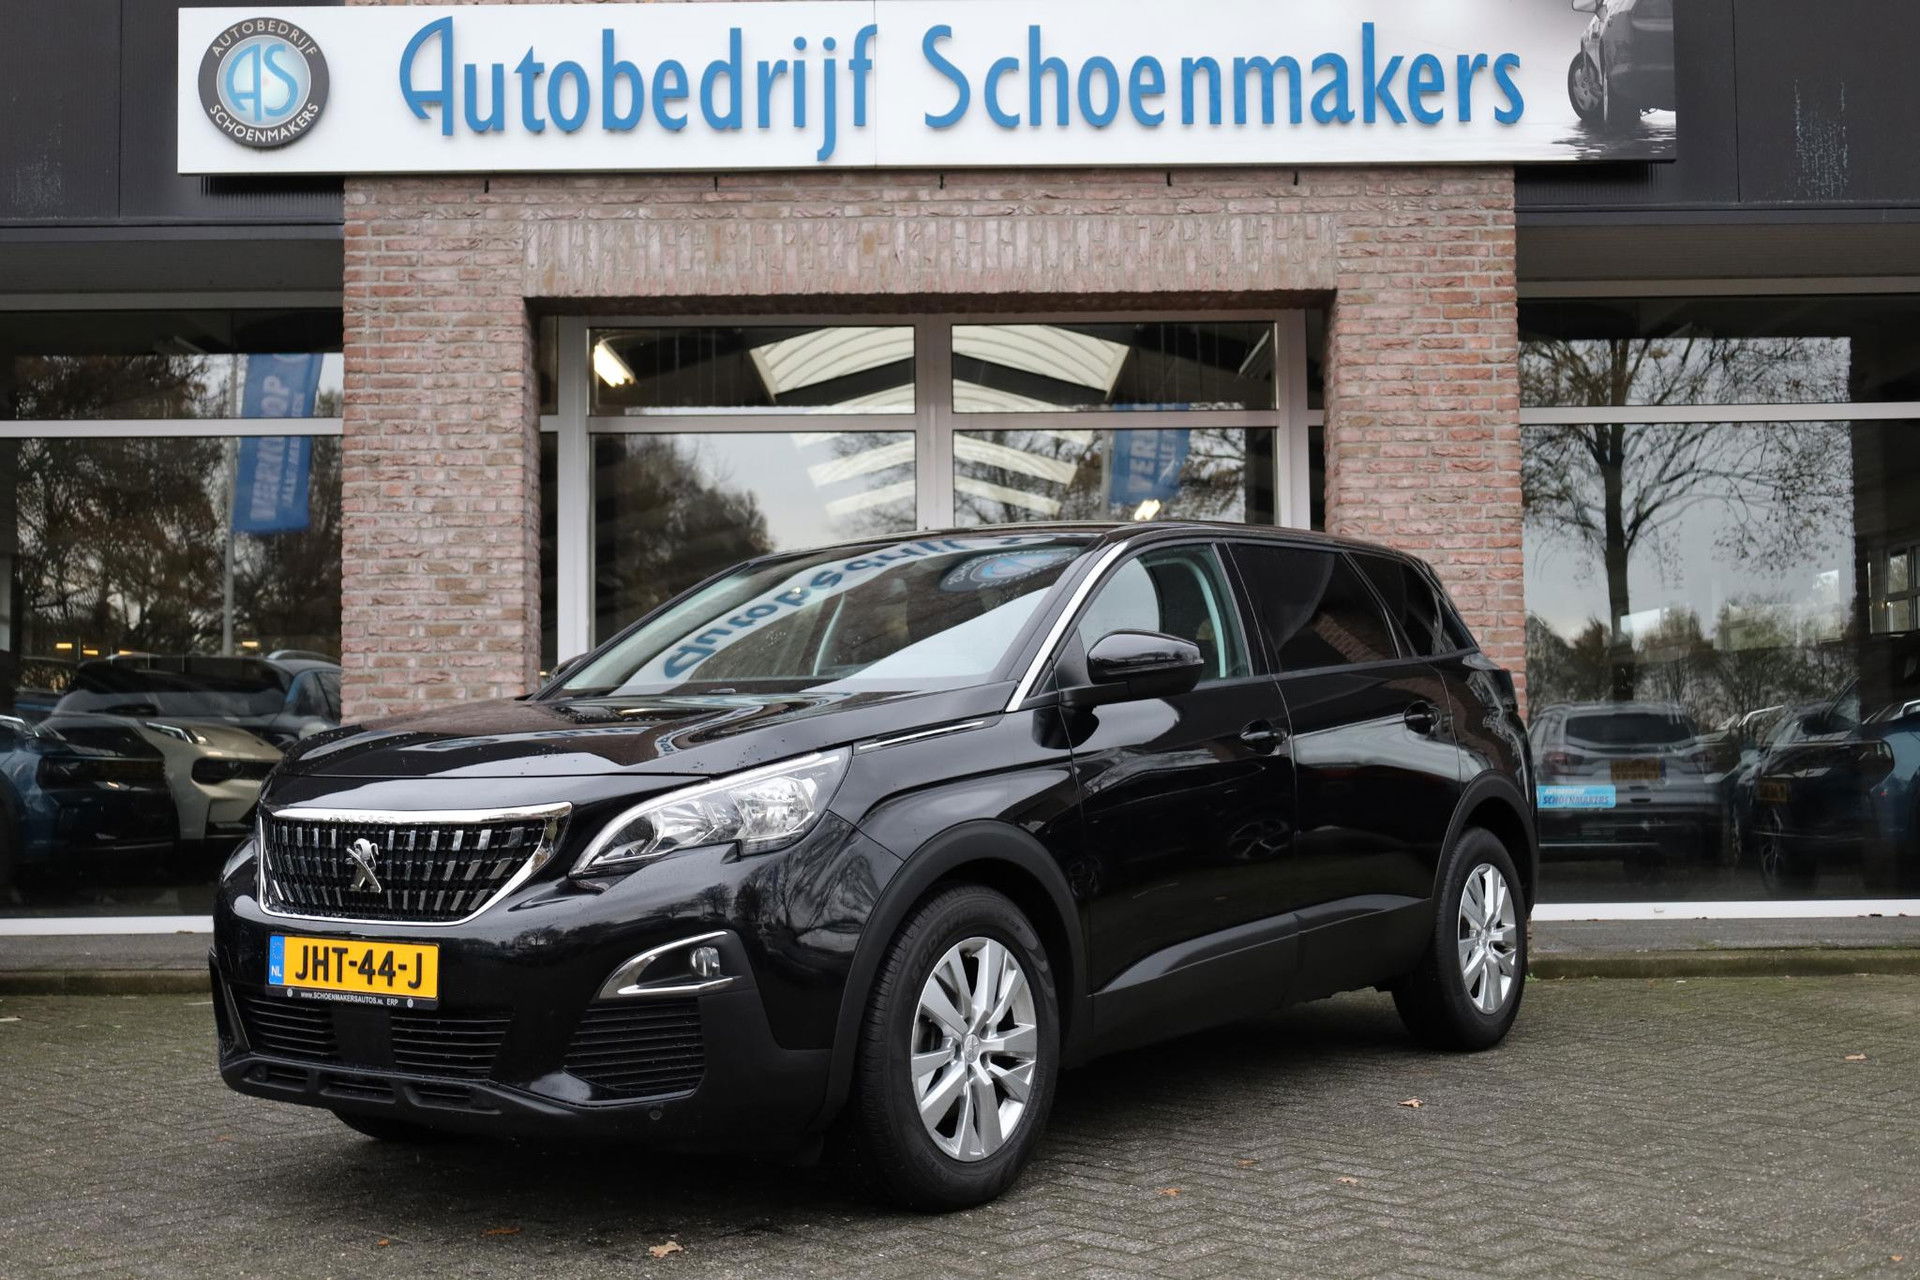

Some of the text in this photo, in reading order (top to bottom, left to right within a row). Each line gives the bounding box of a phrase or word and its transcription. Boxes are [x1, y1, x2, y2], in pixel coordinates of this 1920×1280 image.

[212, 20, 318, 57] AUTOBEDRIJF
[226, 43, 299, 122] AS
[400, 16, 1525, 162] Autobedrijf Schoenmakers
[210, 102, 319, 142] SCHOENMAKERS
[271, 965, 282, 977] NL
[295, 944, 423, 989] JHT-44-J
[386, 998, 399, 1006] ERP
